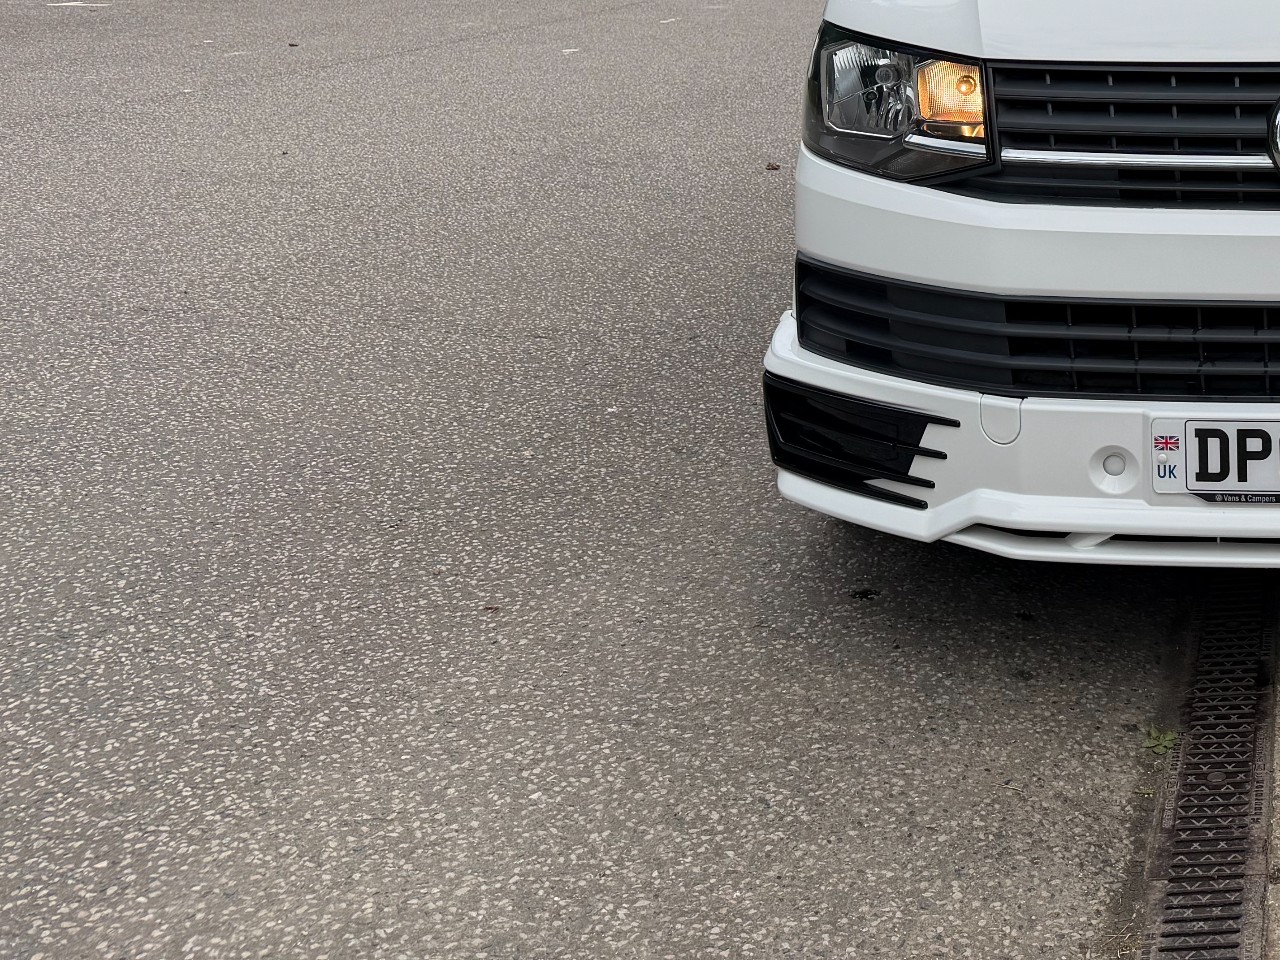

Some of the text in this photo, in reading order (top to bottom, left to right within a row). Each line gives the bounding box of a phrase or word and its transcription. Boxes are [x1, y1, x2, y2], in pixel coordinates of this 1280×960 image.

[1157, 464, 1178, 479] UK
[1223, 494, 1276, 503] Vans & Campers
